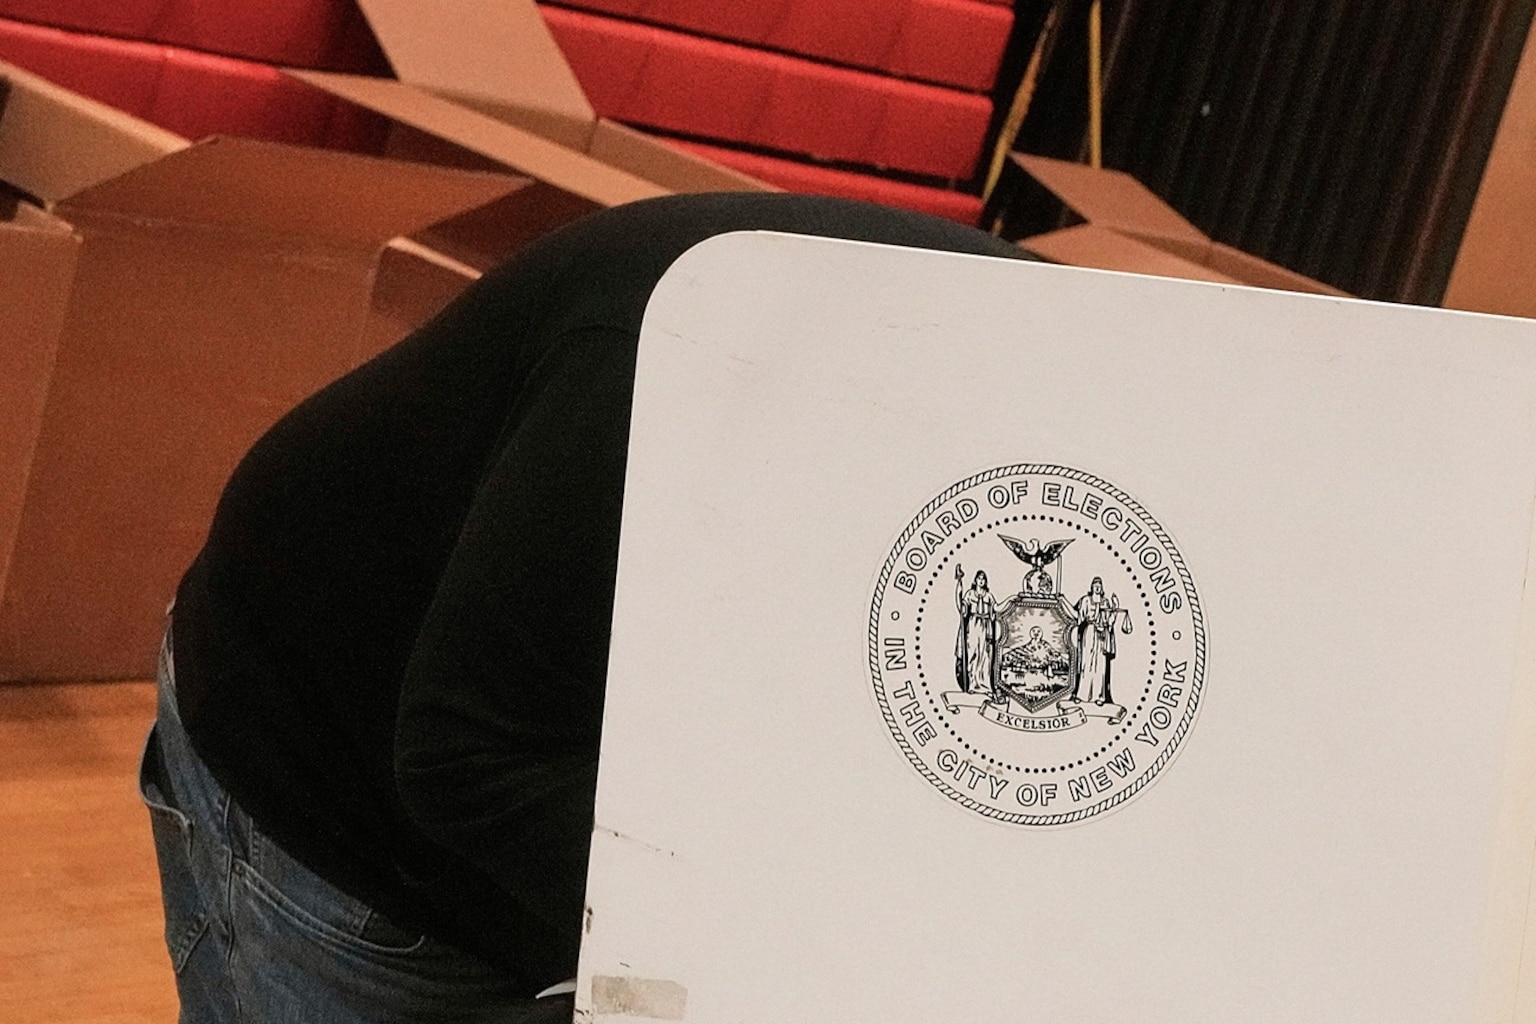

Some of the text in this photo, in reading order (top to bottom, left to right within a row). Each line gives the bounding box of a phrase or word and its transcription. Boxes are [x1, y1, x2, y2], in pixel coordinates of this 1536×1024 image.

[893, 480, 1183, 615] BOARD OF ELECTIONS
[884, 637, 1188, 807] IN THE CITY OF NEW YORK
[996, 711, 1071, 731] EXCELSIOR
